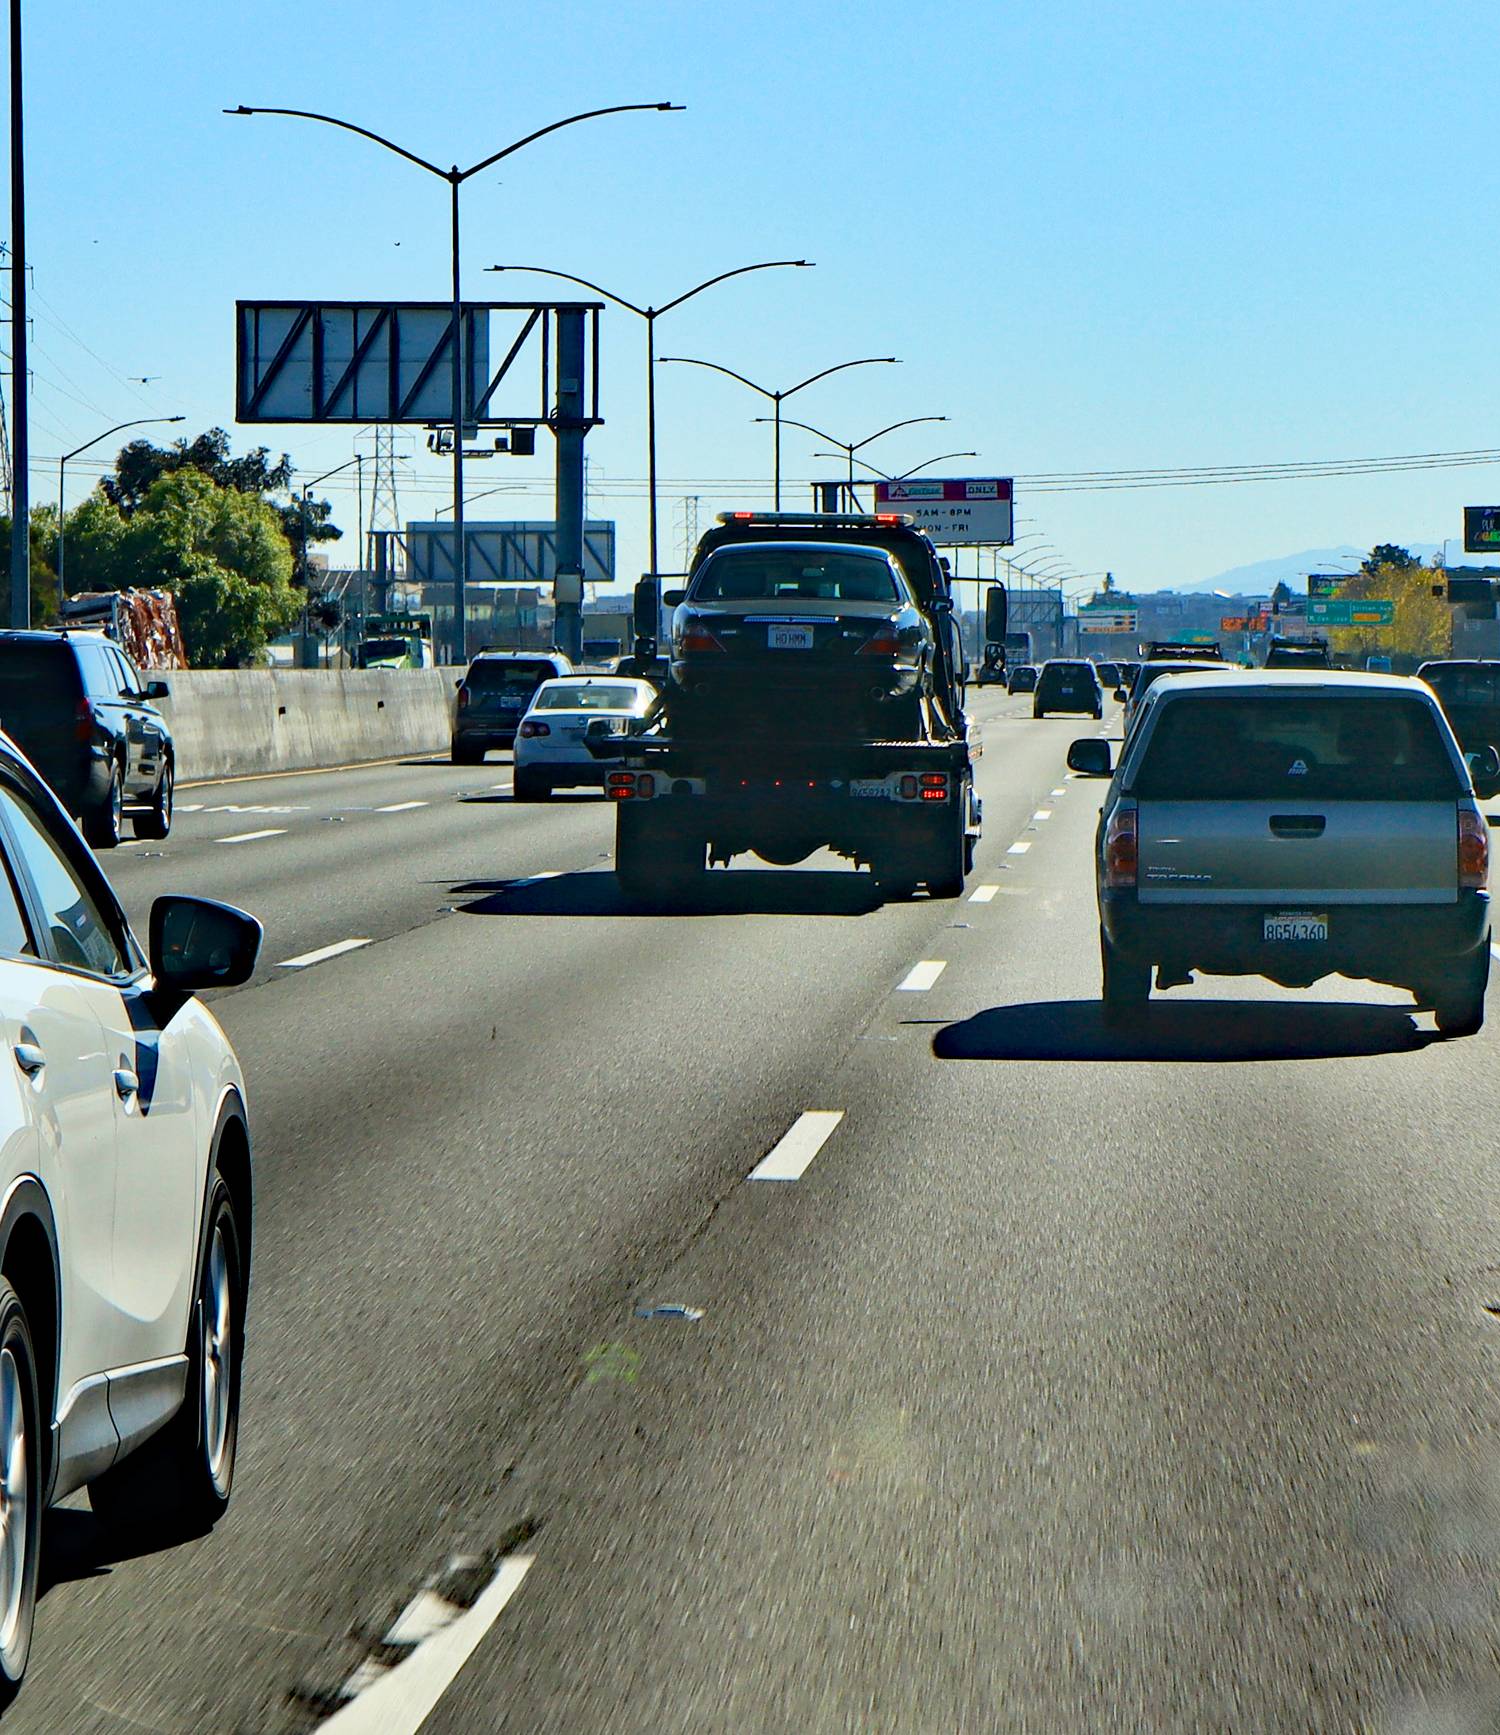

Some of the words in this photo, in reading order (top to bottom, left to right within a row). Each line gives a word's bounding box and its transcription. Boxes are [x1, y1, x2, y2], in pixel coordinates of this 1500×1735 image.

[968, 485, 996, 495] ONLY
[916, 508, 939, 517] 5AM
[952, 524, 969, 532] FRI
[1266, 923, 1326, 940] 8G54360
